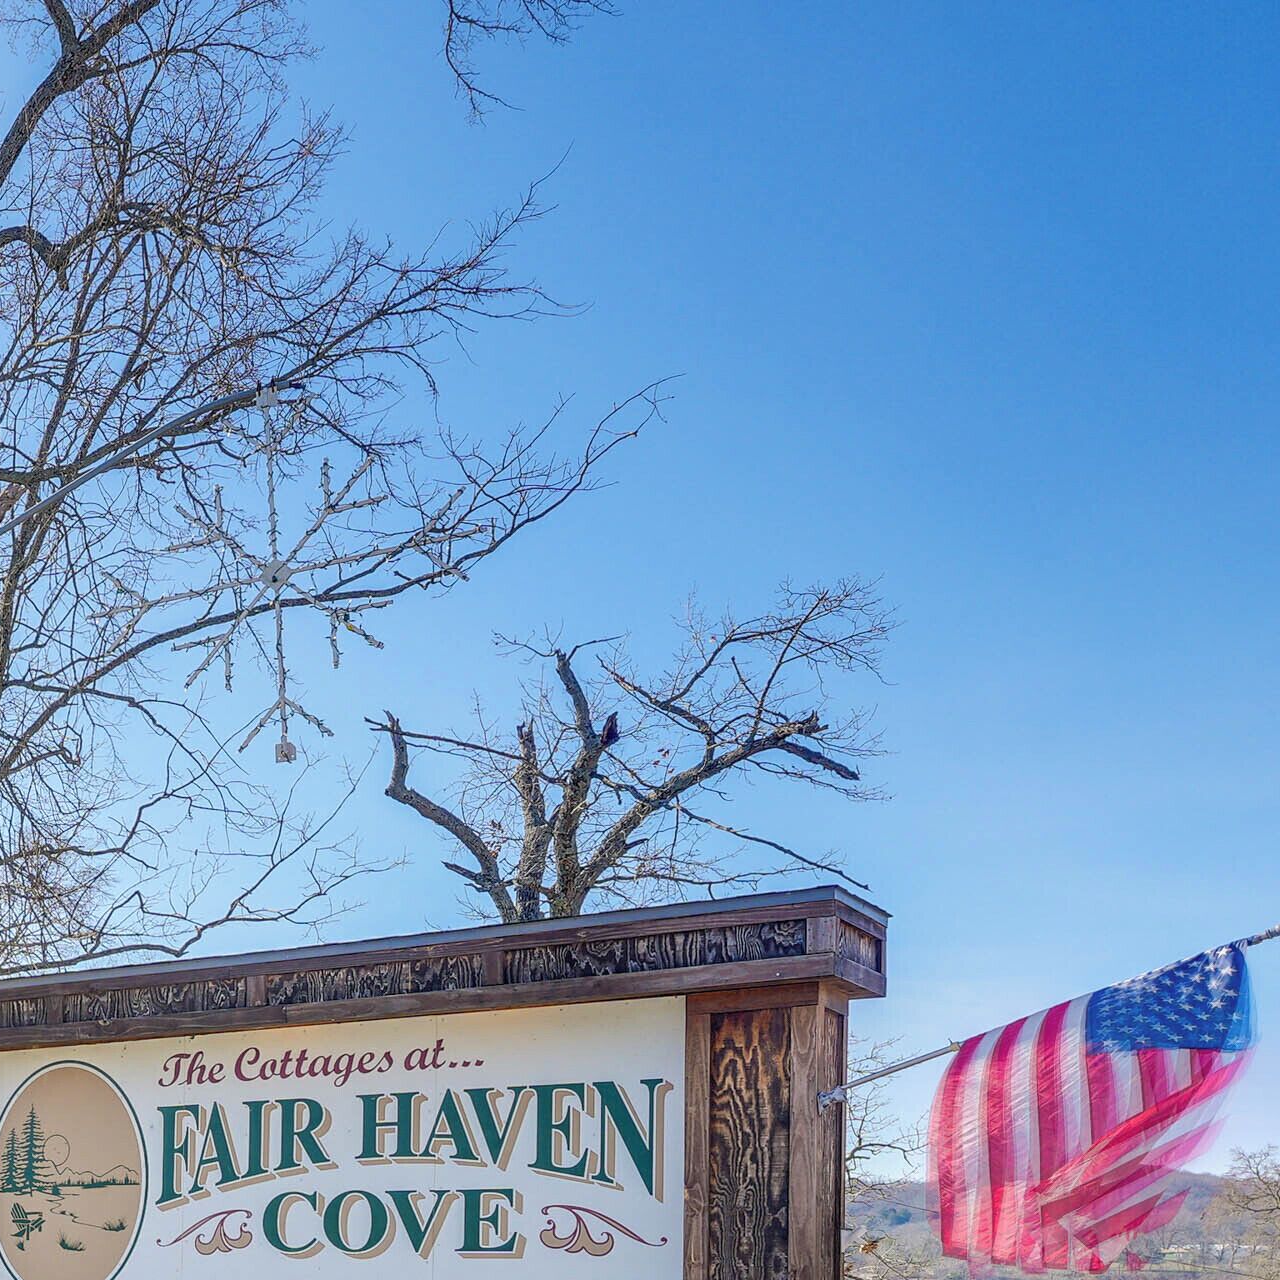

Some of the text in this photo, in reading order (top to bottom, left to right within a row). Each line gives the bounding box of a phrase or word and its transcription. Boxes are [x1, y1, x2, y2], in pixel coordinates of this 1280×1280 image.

[157, 1050, 226, 1088] The
[233, 1046, 395, 1088] Cottages
[154, 1077, 670, 1209] FAIR HAVEN
[261, 1188, 523, 1257] COVE
